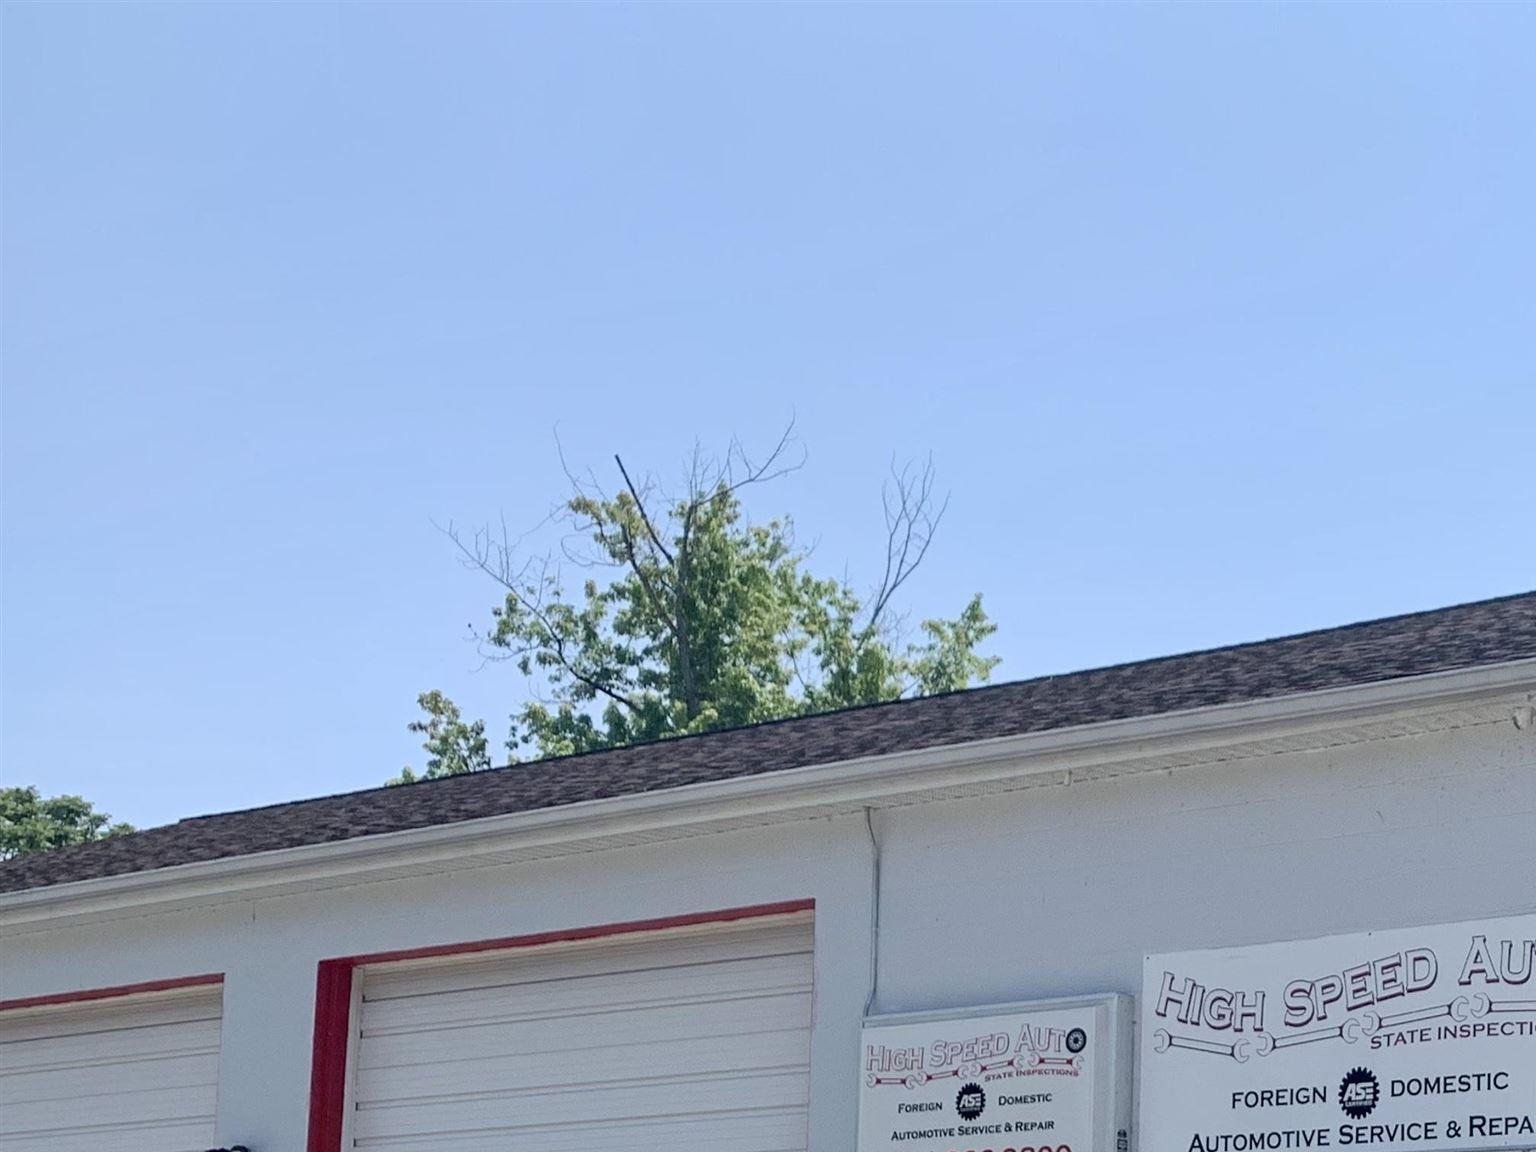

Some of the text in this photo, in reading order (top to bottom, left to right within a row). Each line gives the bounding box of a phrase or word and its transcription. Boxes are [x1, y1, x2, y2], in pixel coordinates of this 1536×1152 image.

[1155, 971, 1265, 1032] HIGH
[1283, 947, 1438, 1028] SPEED
[1370, 1029, 1431, 1050] STATE
[866, 1045, 924, 1072] HIGH
[929, 1032, 1010, 1067] SPEED
[985, 1068, 1079, 1082] STATE INSPECTIONS
[1231, 1072, 1509, 1110] FOREIGN ASE DOMESTIC
[898, 1093, 1053, 1114] FOREIGN ASE DOMESTIC
[891, 1120, 1055, 1141] AUTOMOTIVE SERVICE & REPAIR
[1338, 1121, 1437, 1147] SERVICE
[1446, 1120, 1462, 1138] &
